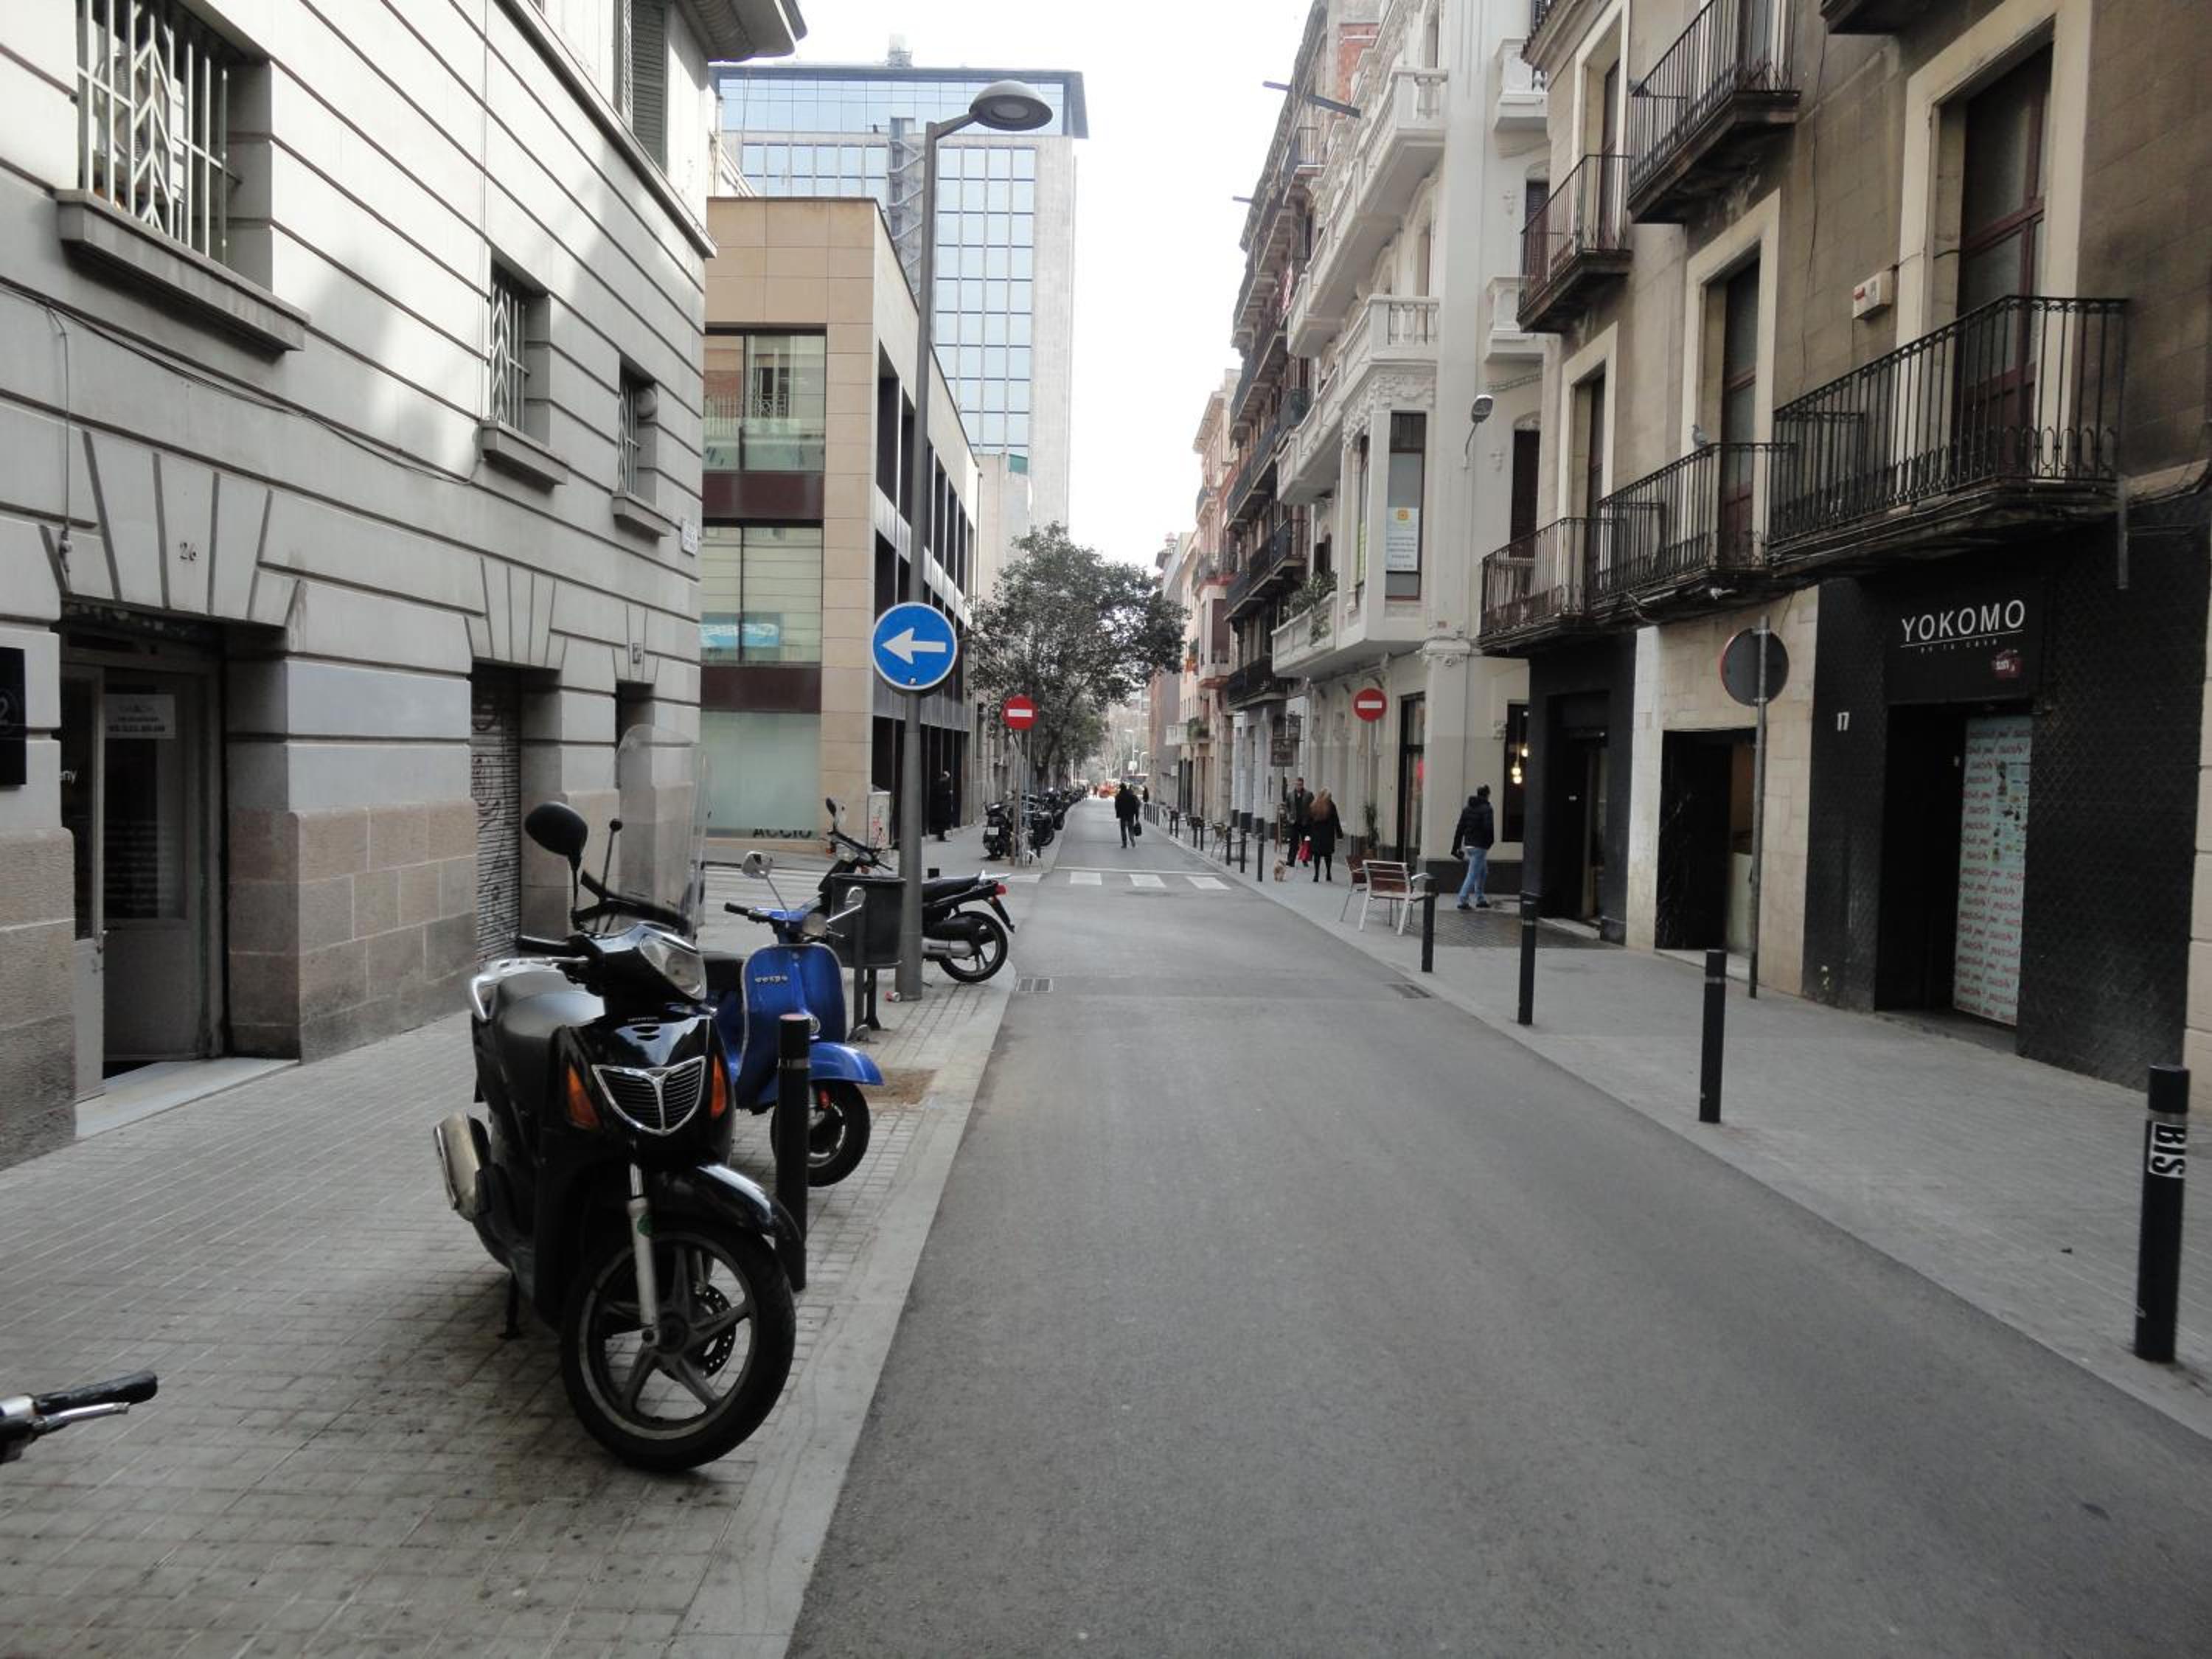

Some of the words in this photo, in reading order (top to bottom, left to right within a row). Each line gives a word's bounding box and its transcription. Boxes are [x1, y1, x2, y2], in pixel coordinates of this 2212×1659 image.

[179, 541, 199, 561] 26
[1901, 599, 2025, 641] YOKOMO
[1837, 711, 1850, 732] 17
[2152, 1124, 2185, 1174] BIS
